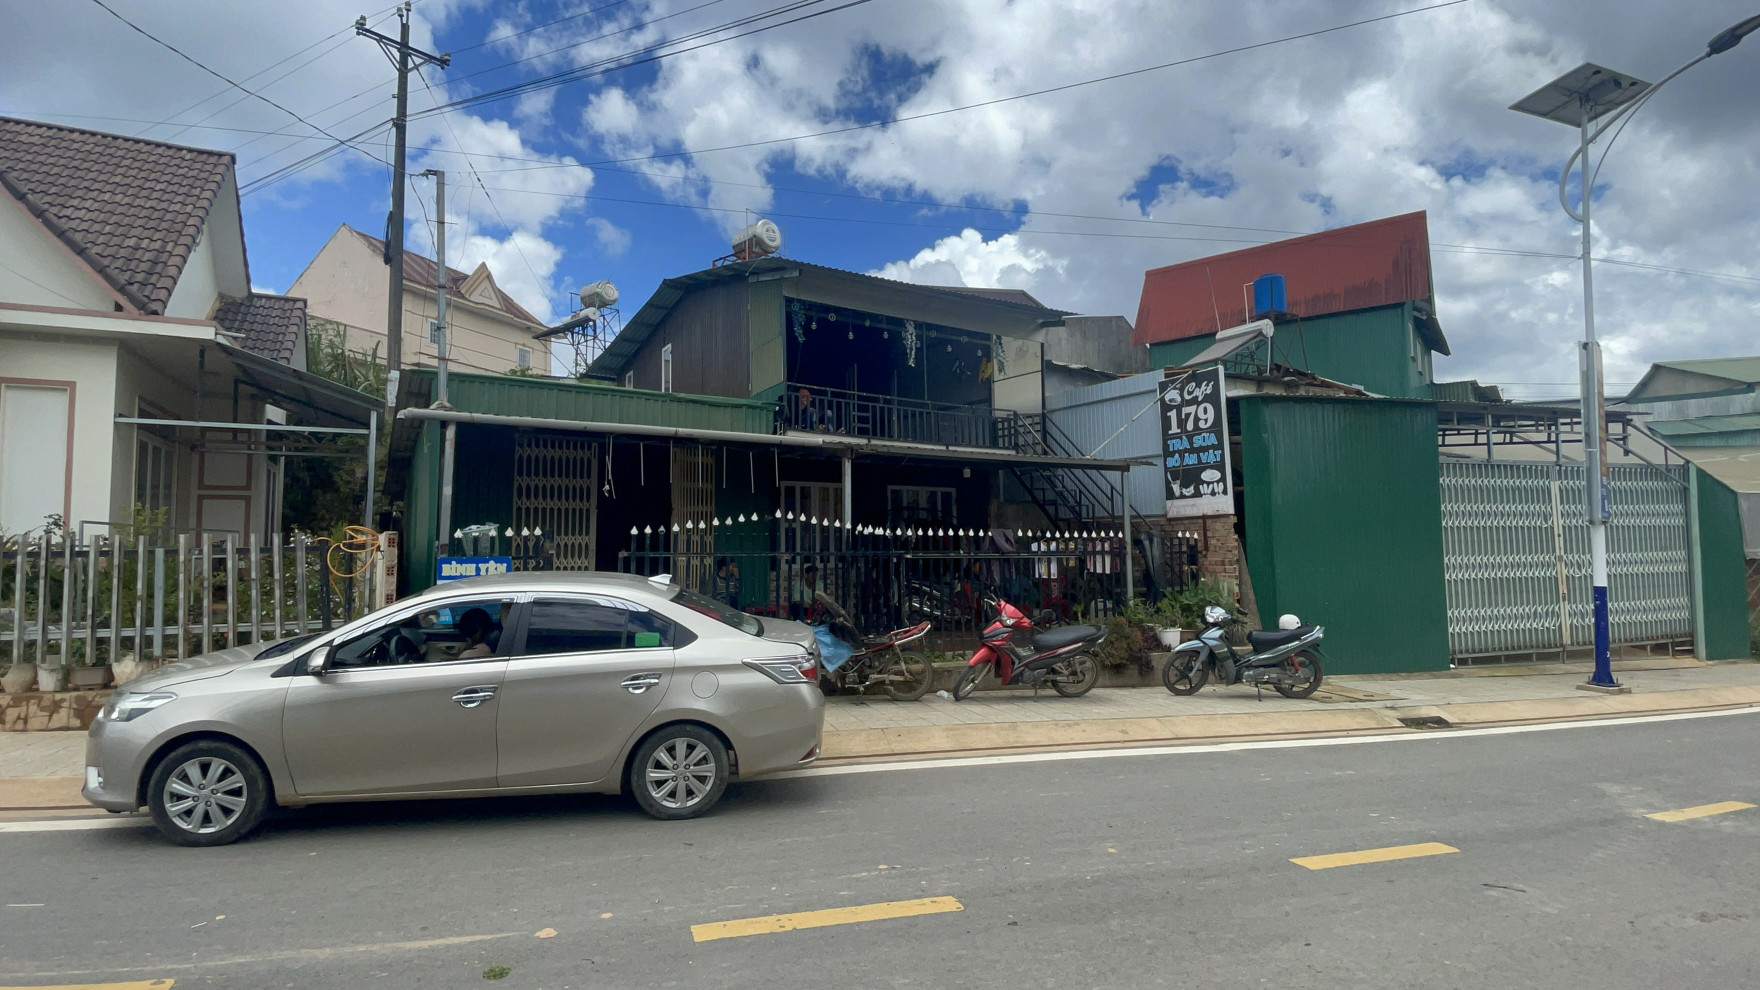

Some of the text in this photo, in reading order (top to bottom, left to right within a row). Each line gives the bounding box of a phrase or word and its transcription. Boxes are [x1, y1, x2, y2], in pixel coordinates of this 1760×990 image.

[1167, 403, 1214, 434] 179
[1168, 433, 1217, 451] TRÀ SỮA
[1200, 450, 1221, 464] VẶT
[442, 560, 507, 576] BÌNH YÊN
